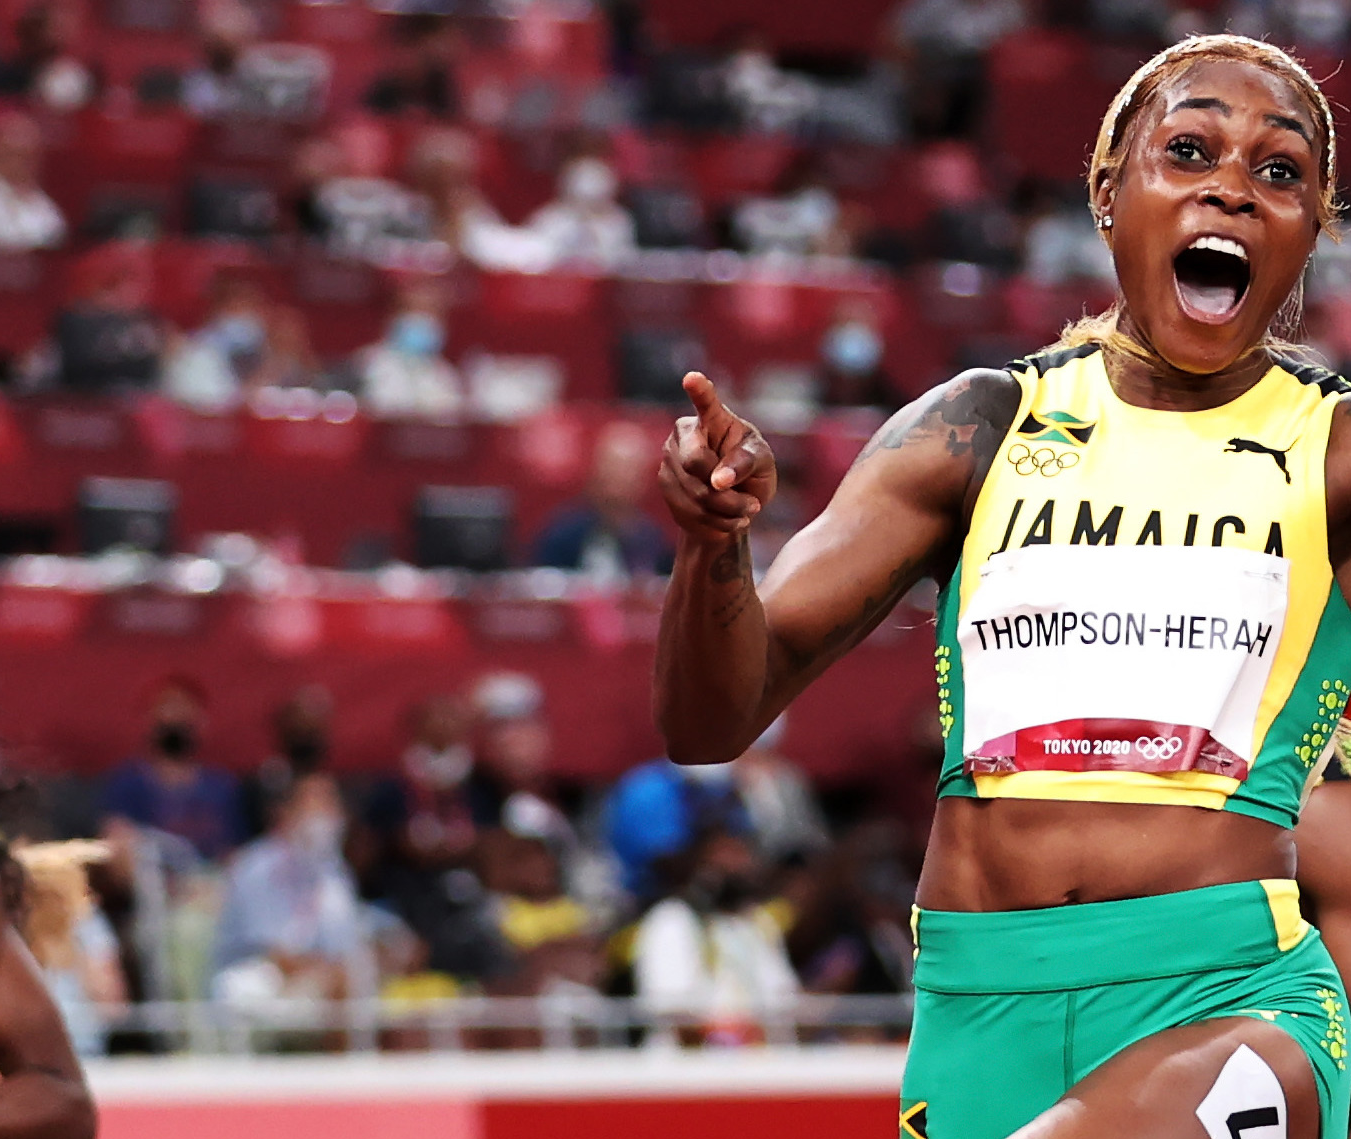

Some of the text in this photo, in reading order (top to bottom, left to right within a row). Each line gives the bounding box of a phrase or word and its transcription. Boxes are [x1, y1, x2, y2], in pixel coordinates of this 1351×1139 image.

[988, 499, 1284, 560] JAMAICA
[971, 611, 1272, 657] THOMPSON-HERAH
[1042, 739, 1131, 755] TOKYO 2020
